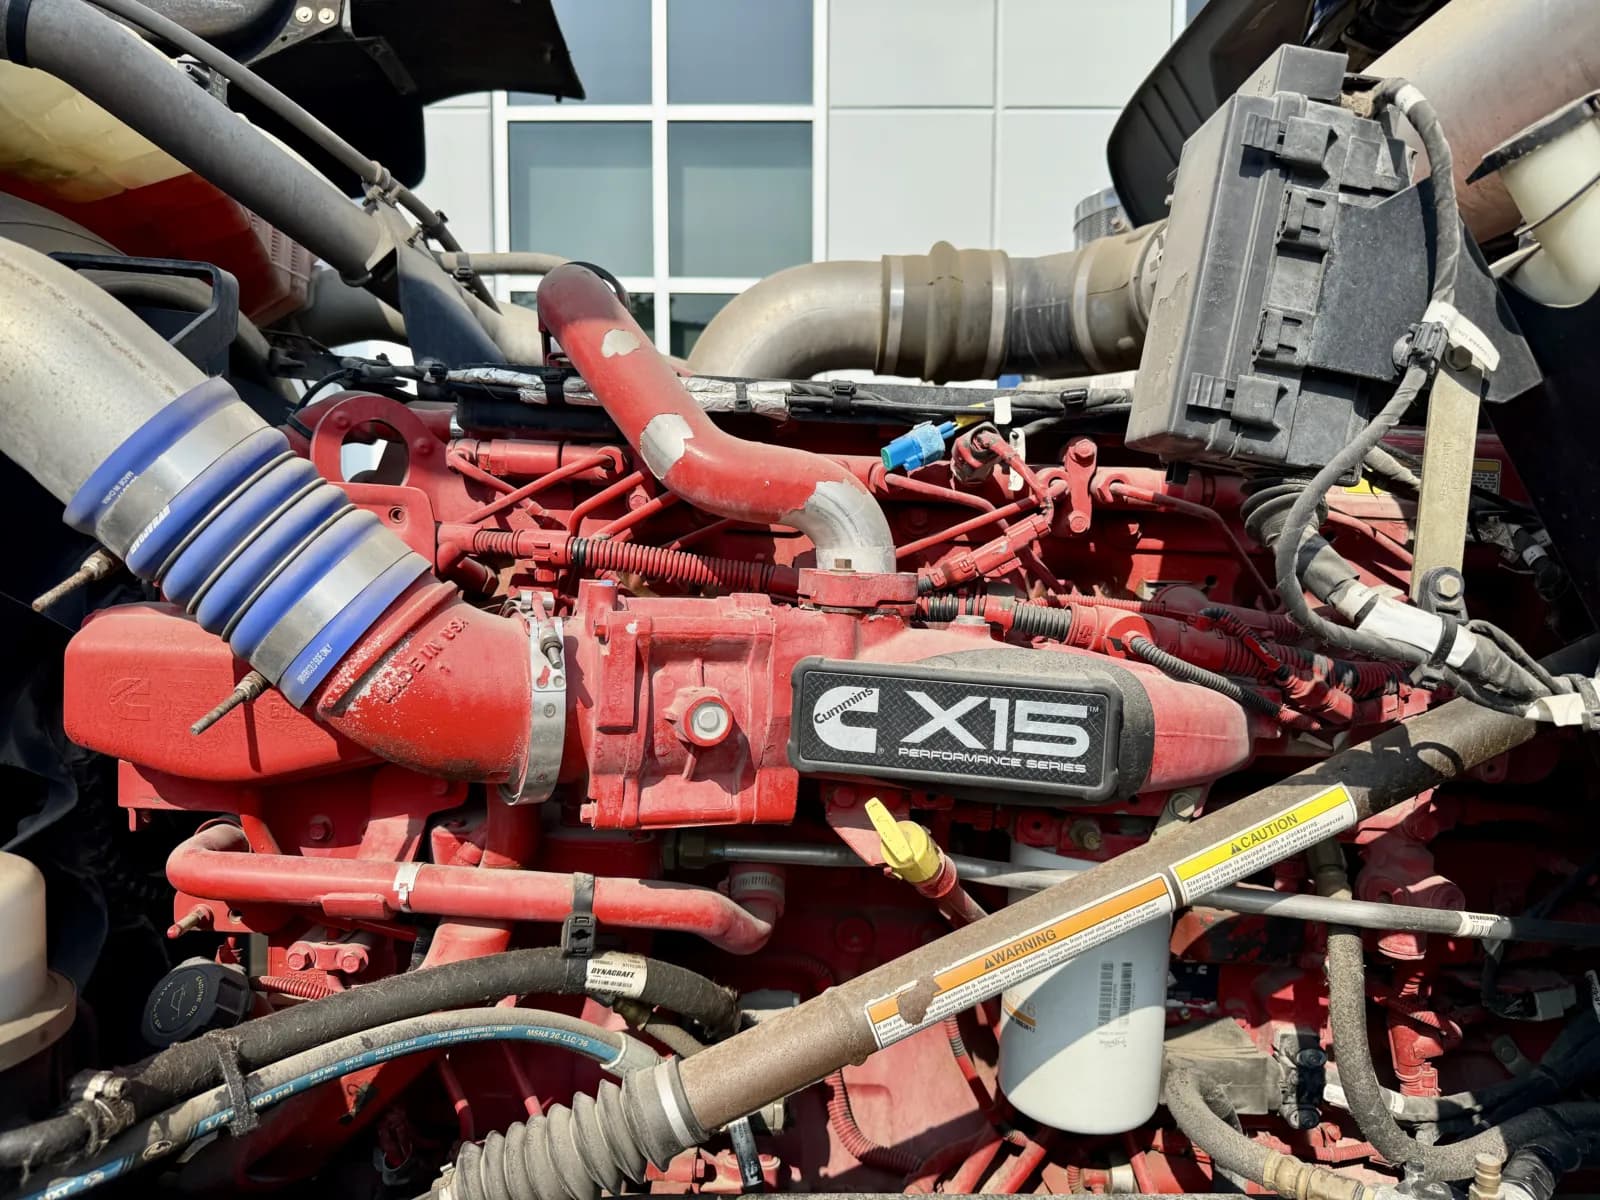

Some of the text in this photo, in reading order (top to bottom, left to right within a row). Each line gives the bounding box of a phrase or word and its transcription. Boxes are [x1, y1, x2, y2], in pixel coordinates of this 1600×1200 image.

[114, 484, 121, 492] IN
[418, 639, 443, 659] IN
[439, 616, 469, 643] USA
[814, 688, 874, 724] Cummins
[900, 691, 1090, 757] X15
[898, 748, 1087, 773] PERFORMANCE SERIES
[1240, 813, 1298, 848] CAUTION
[993, 929, 1057, 965] WARNING
[591, 967, 636, 978] DYNACRAFT
[526, 1026, 548, 1040] MSHA
[247, 1093, 273, 1109] 000
[273, 1084, 294, 1098] psi
